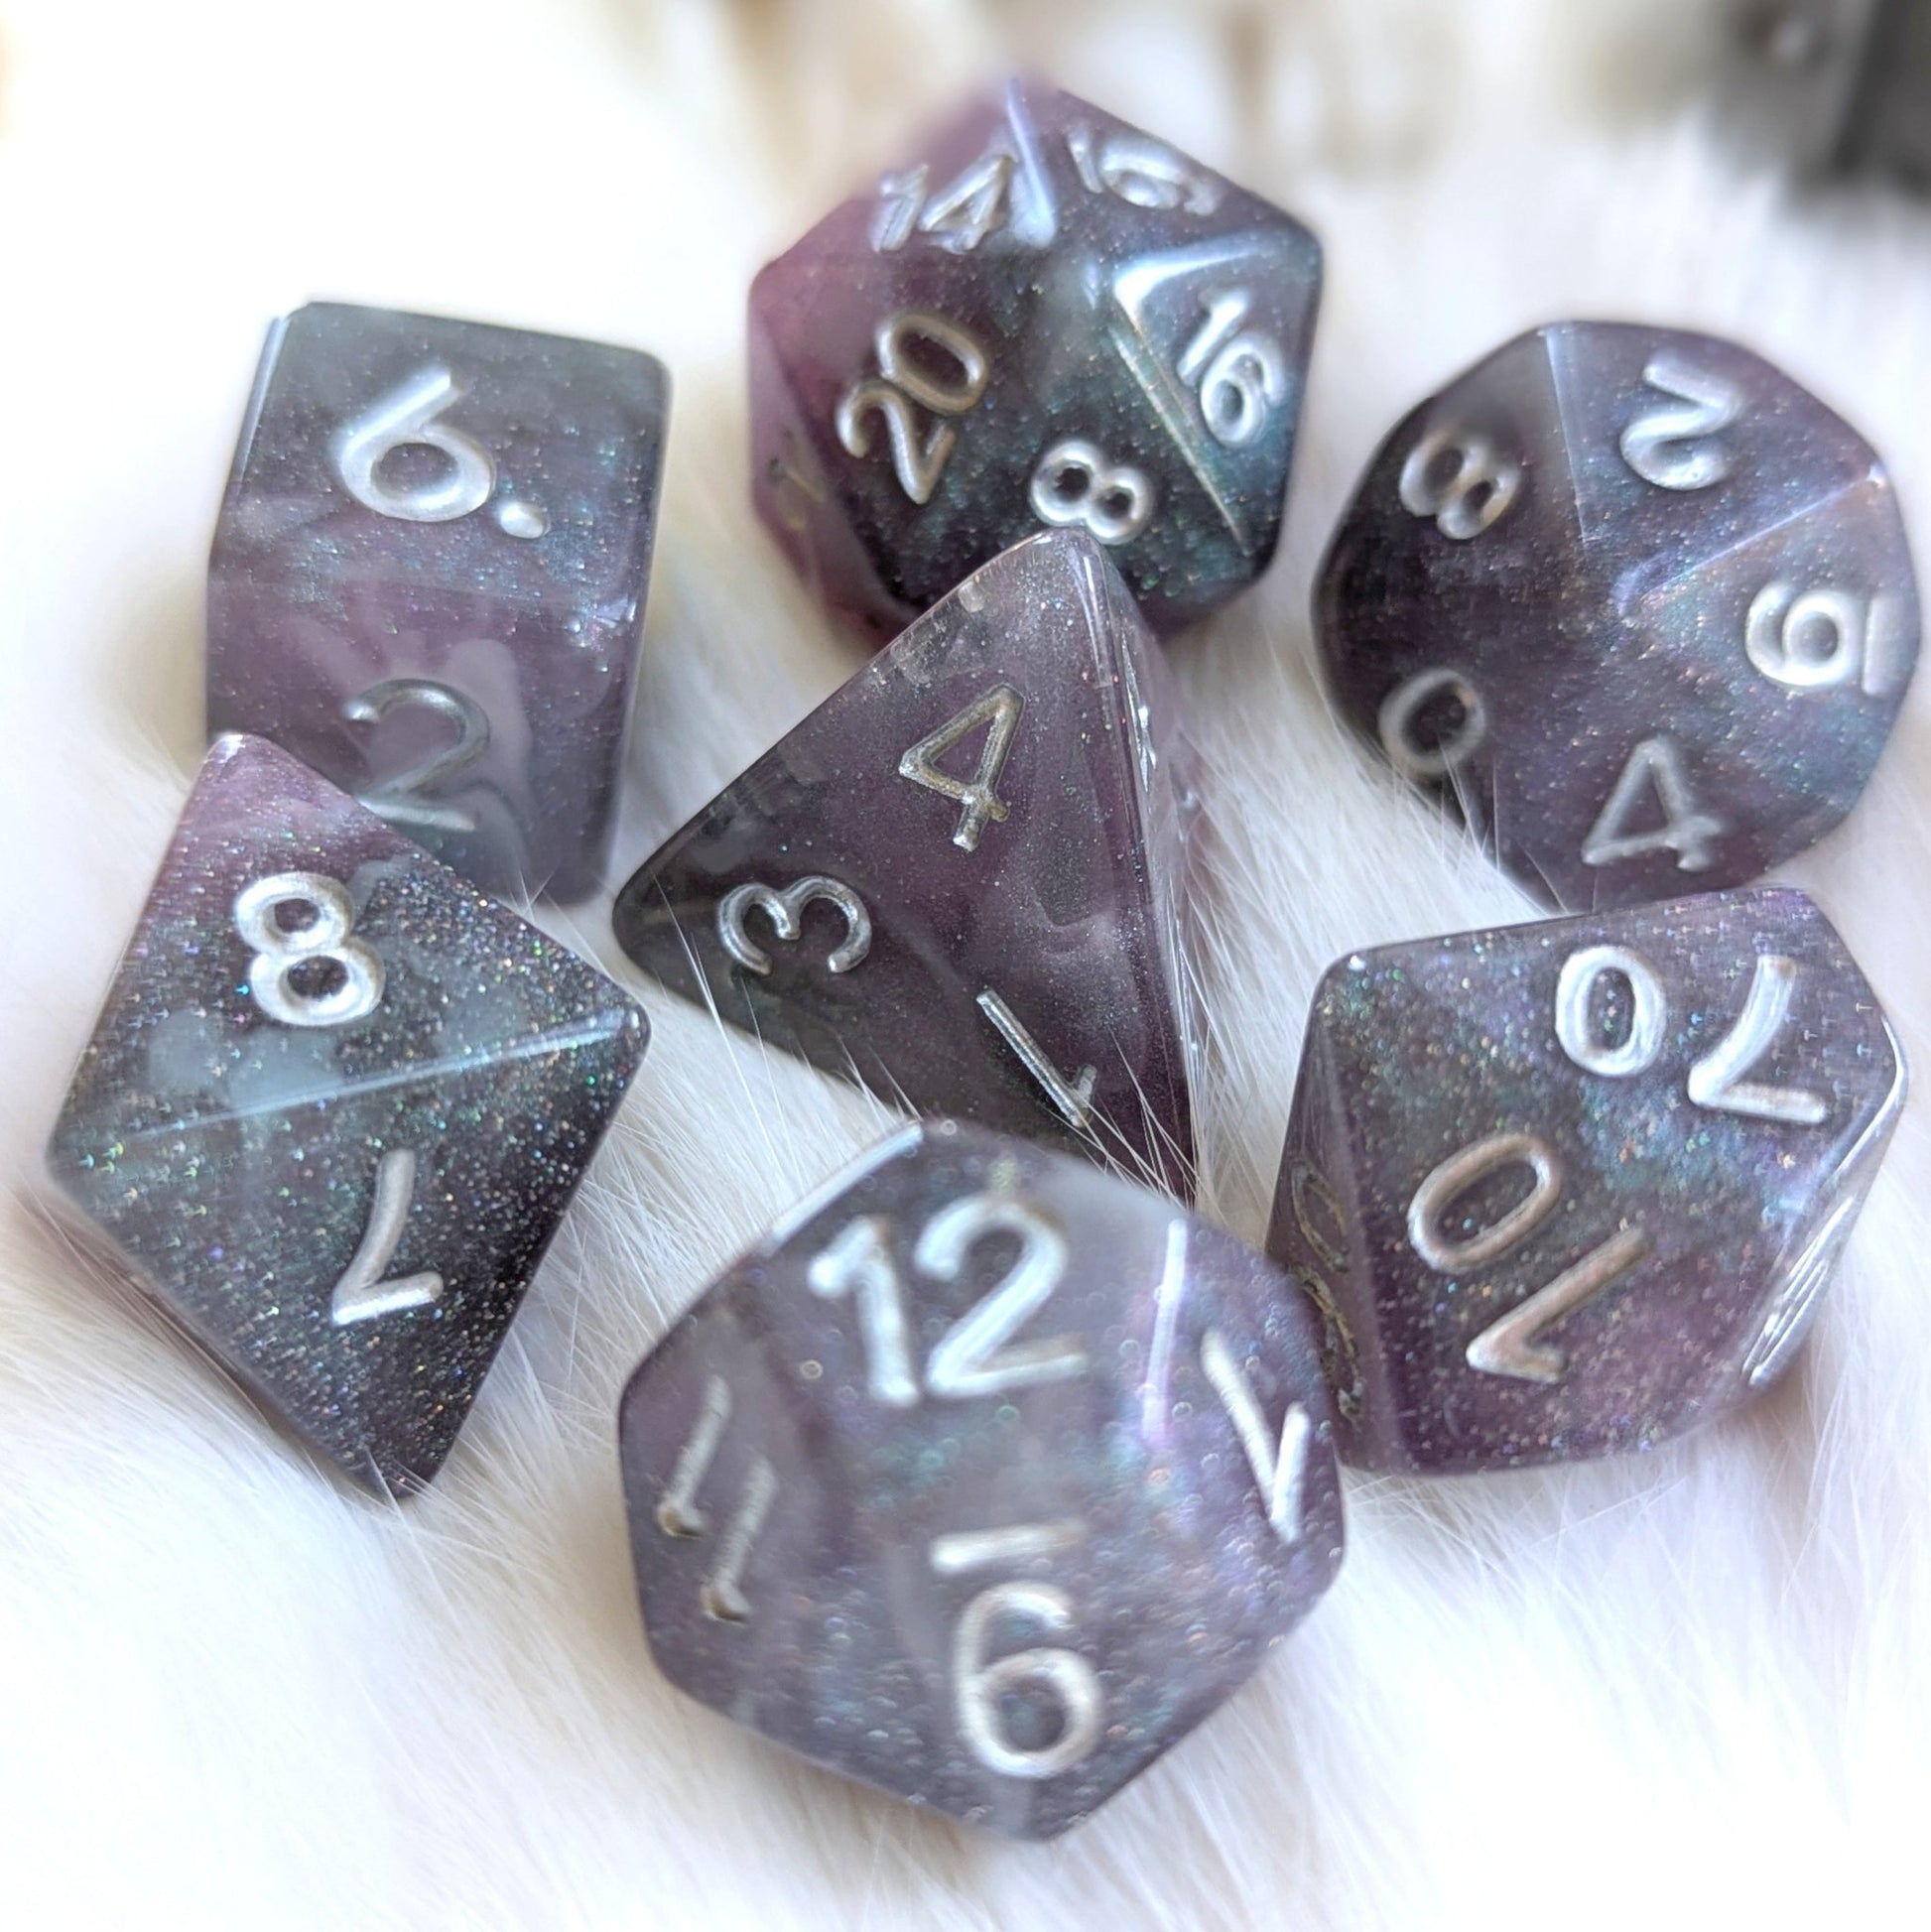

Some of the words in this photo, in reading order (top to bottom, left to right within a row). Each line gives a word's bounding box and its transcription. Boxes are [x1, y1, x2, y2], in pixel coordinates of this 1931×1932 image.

[870, 151, 1018, 254] 14
[836, 309, 988, 504] 20
[1178, 290, 1285, 449] 16
[1619, 349, 1742, 490] 2
[1030, 440, 1157, 546] 8
[1399, 427, 1523, 540] 8
[342, 678, 491, 833] 2
[898, 683, 1025, 851] 4
[1377, 667, 1486, 777] 0
[1582, 732, 1724, 871] 4
[234, 870, 386, 1028] 8
[717, 875, 872, 976] 3
[976, 989, 1098, 1128] 1
[1555, 945, 1829, 1125] 70
[331, 1149, 444, 1327] 7
[809, 1194, 1090, 1409] 12
[1406, 1132, 1655, 1385] 10
